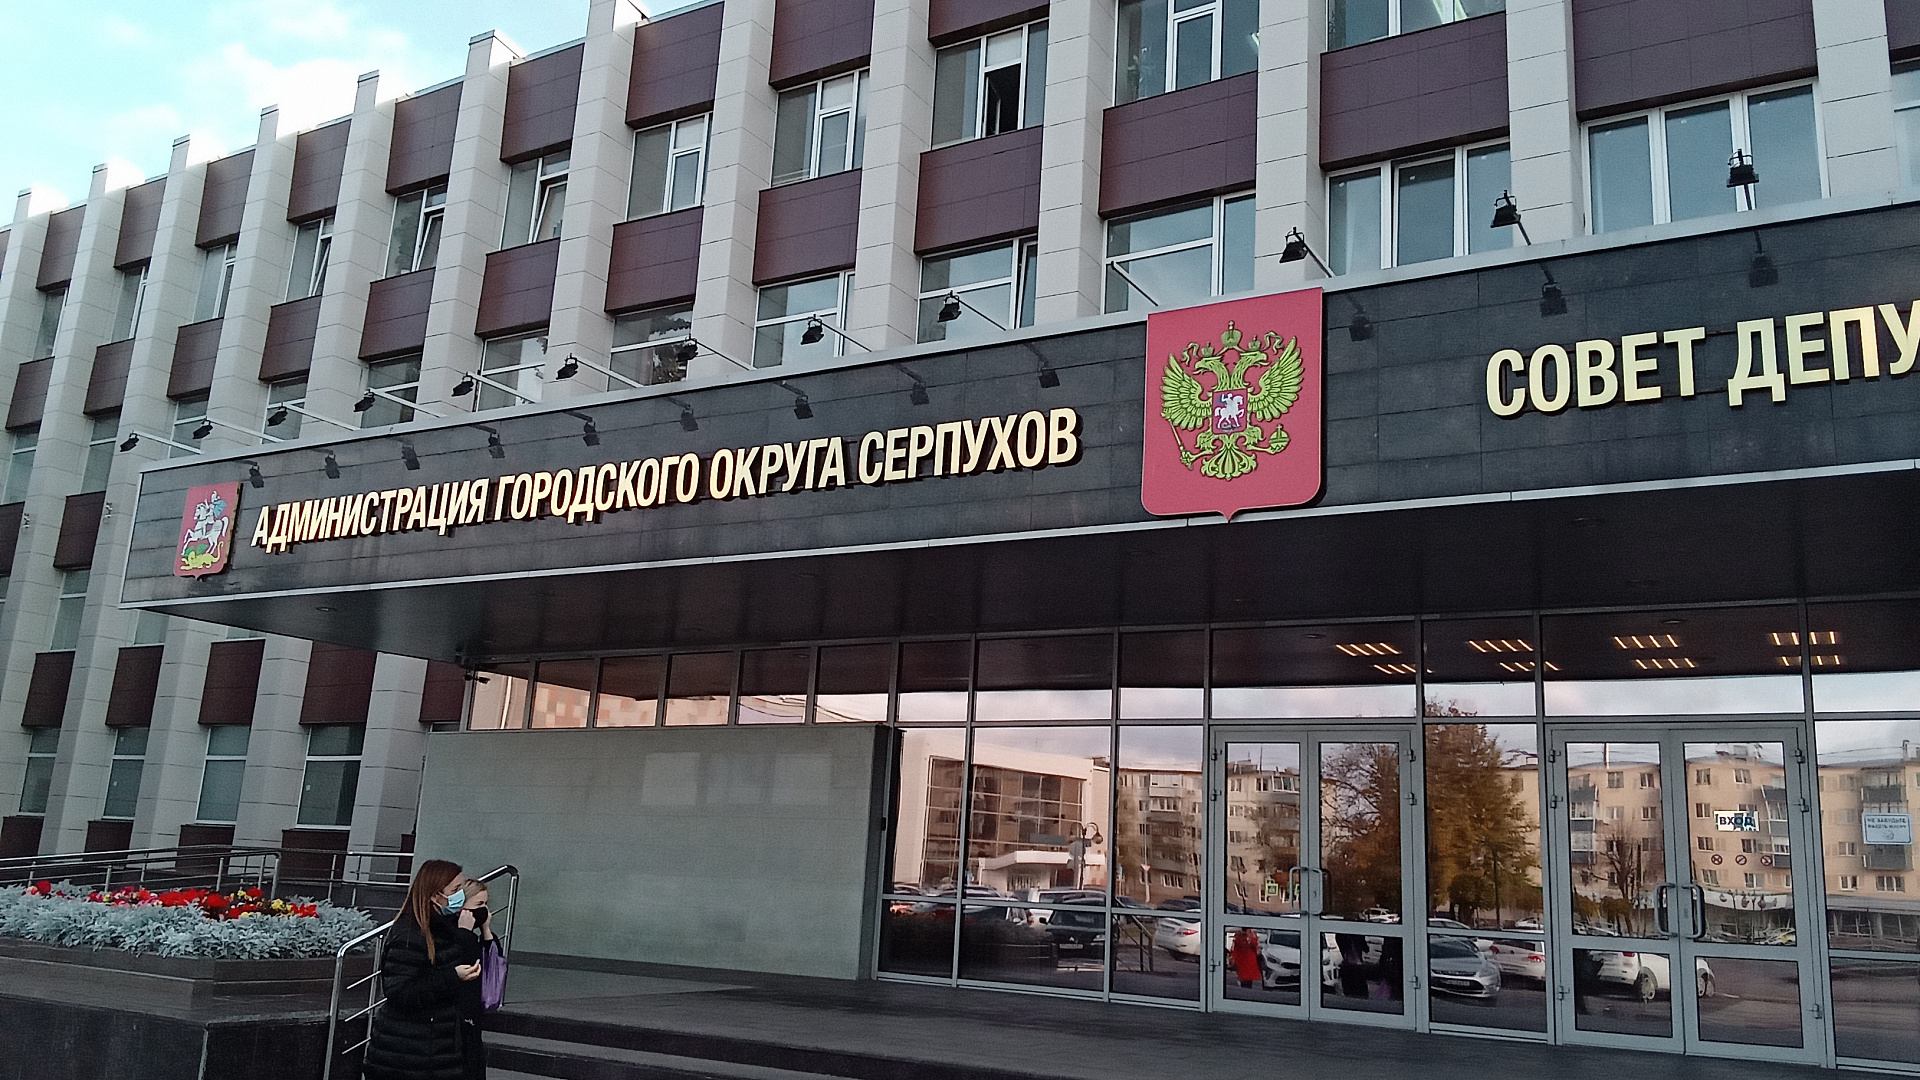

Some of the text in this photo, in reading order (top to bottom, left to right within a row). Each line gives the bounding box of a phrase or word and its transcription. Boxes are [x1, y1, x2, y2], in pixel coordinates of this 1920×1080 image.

[1485, 299, 1920, 417] СОВЕТ ДЕПУ
[250, 407, 1078, 554] АДМИНИСТРАЦИЯ ГОРОДСКОГО ОКРУГА СЕРПУХОВ
[1719, 816, 1755, 827] ВХОД
